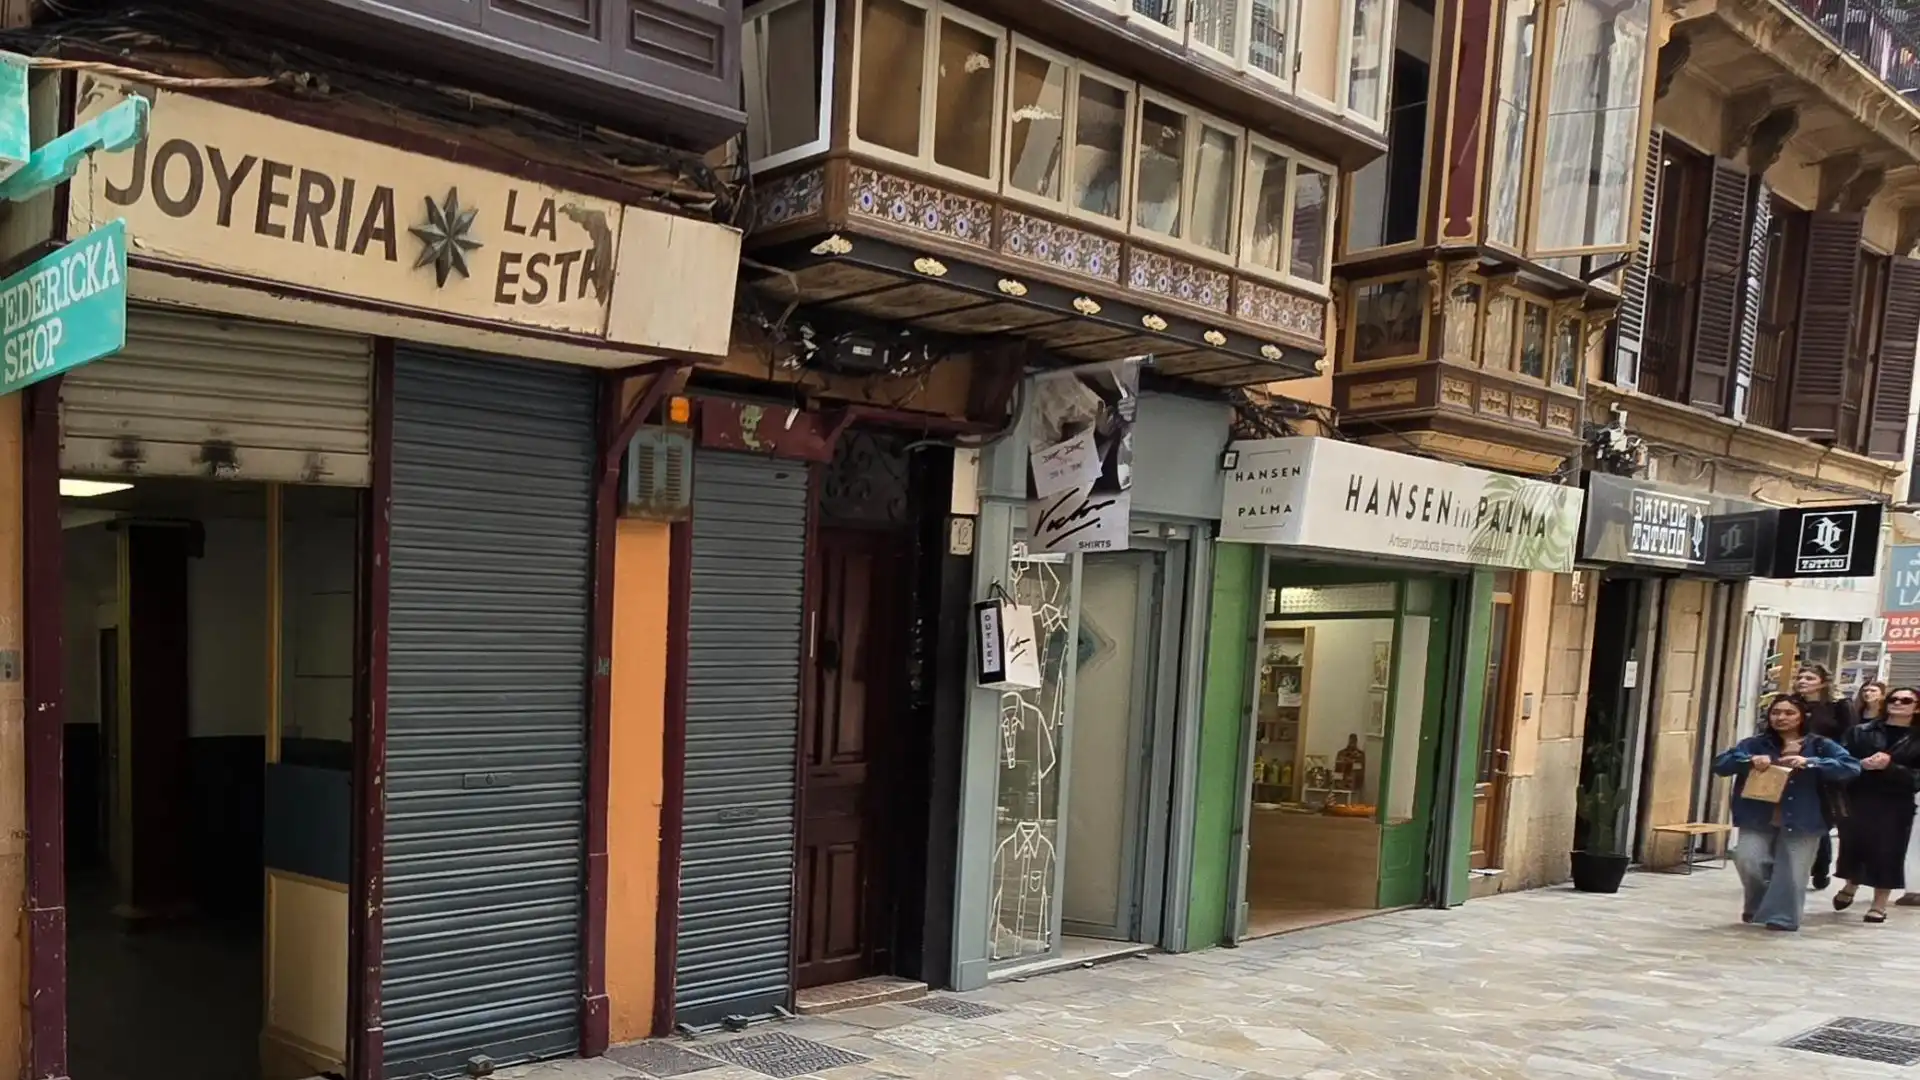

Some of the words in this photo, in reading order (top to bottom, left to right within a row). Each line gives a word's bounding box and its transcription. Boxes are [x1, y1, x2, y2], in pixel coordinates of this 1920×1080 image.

[104, 108, 398, 262] JOYERIA
[503, 189, 557, 242] LA
[0, 235, 120, 335] EDERICKA
[4, 317, 63, 386] SHOP
[1235, 466, 1301, 482] HANSEN
[1261, 486, 1272, 495] in
[1238, 504, 1292, 517] PALMA
[1345, 474, 1453, 526] HANSEN
[1453, 499, 1471, 529] in
[1470, 496, 1546, 538] PALMA
[958, 527, 969, 545] 12
[1078, 540, 1112, 549] SHIRTS
[984, 614, 993, 666] OUTLET
